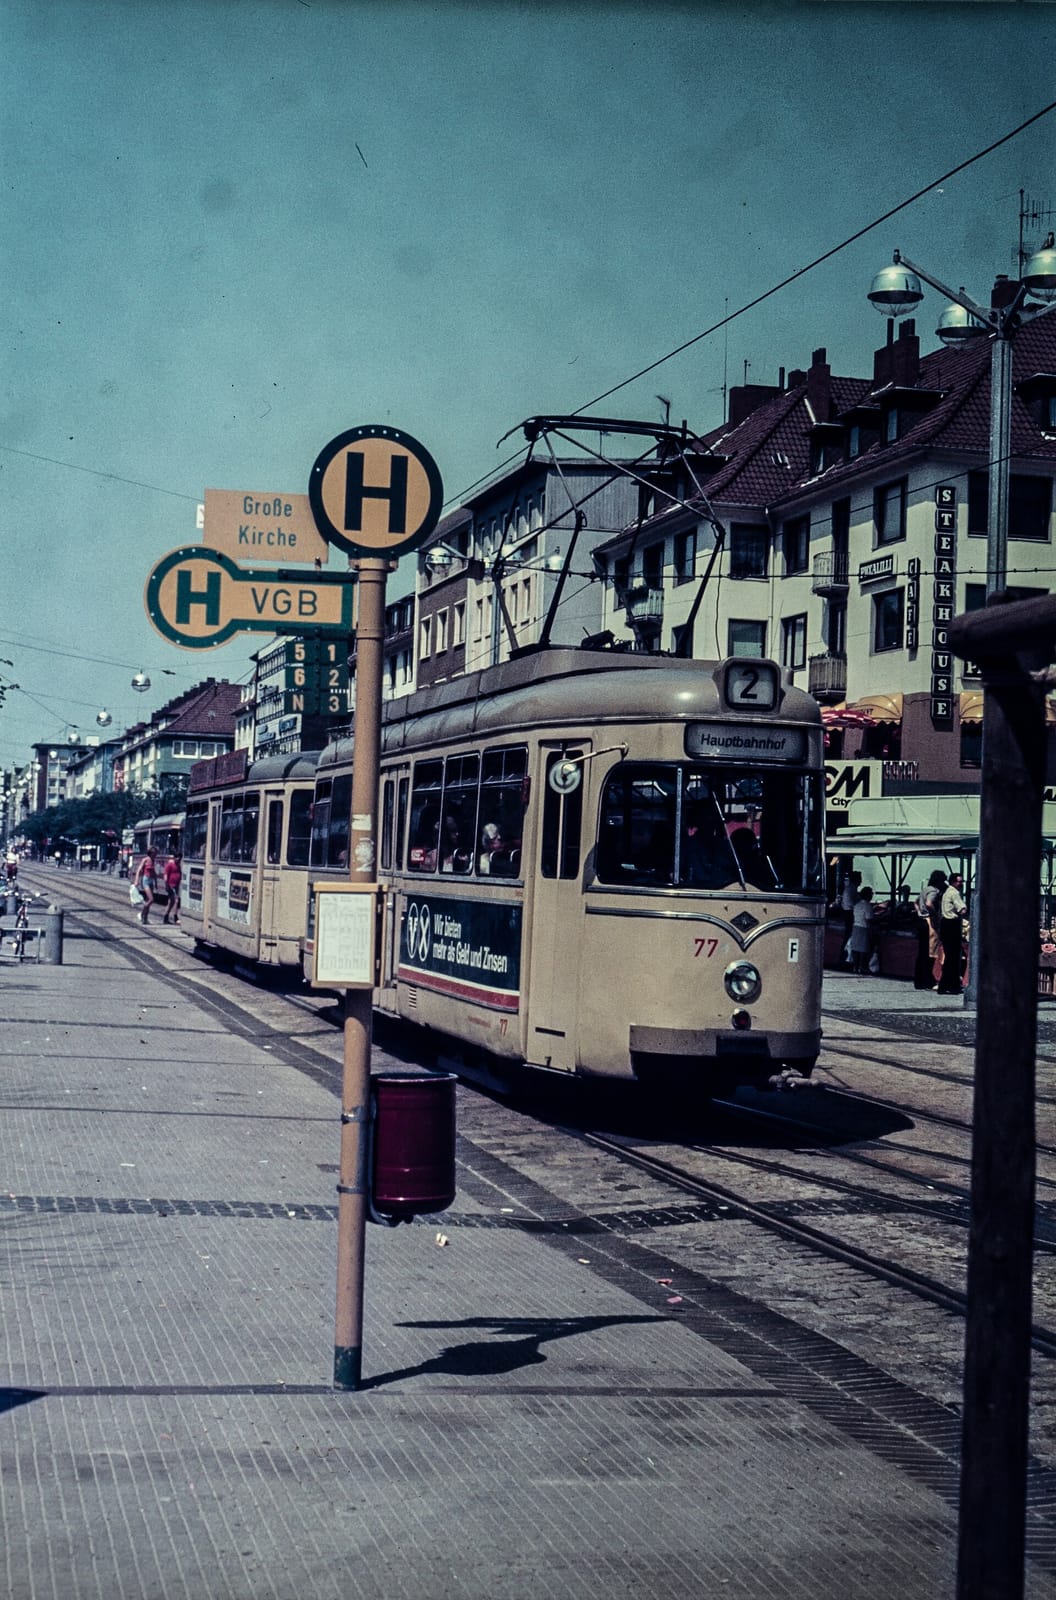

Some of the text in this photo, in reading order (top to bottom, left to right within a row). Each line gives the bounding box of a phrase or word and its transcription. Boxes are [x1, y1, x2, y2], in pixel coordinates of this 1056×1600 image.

[344, 451, 408, 534] H
[243, 496, 293, 517] Große
[238, 525, 297, 547] Kirche
[175, 569, 221, 626] H
[251, 587, 318, 616] VGB
[294, 644, 305, 661] 5
[327, 644, 336, 661] 1
[294, 668, 305, 686] 6
[329, 669, 339, 686] 2
[740, 668, 759, 699] 2
[292, 694, 304, 711] N
[329, 695, 340, 712] 3
[700, 733, 786, 751] Hauptbahnhof
[831, 797, 851, 808] City
[434, 914, 462, 939] Wir bieten
[432, 938, 508, 973] mehr als Geld und Zinsen
[694, 938, 718, 957] 77
[790, 942, 797, 958] F
[500, 1018, 508, 1036] 77
